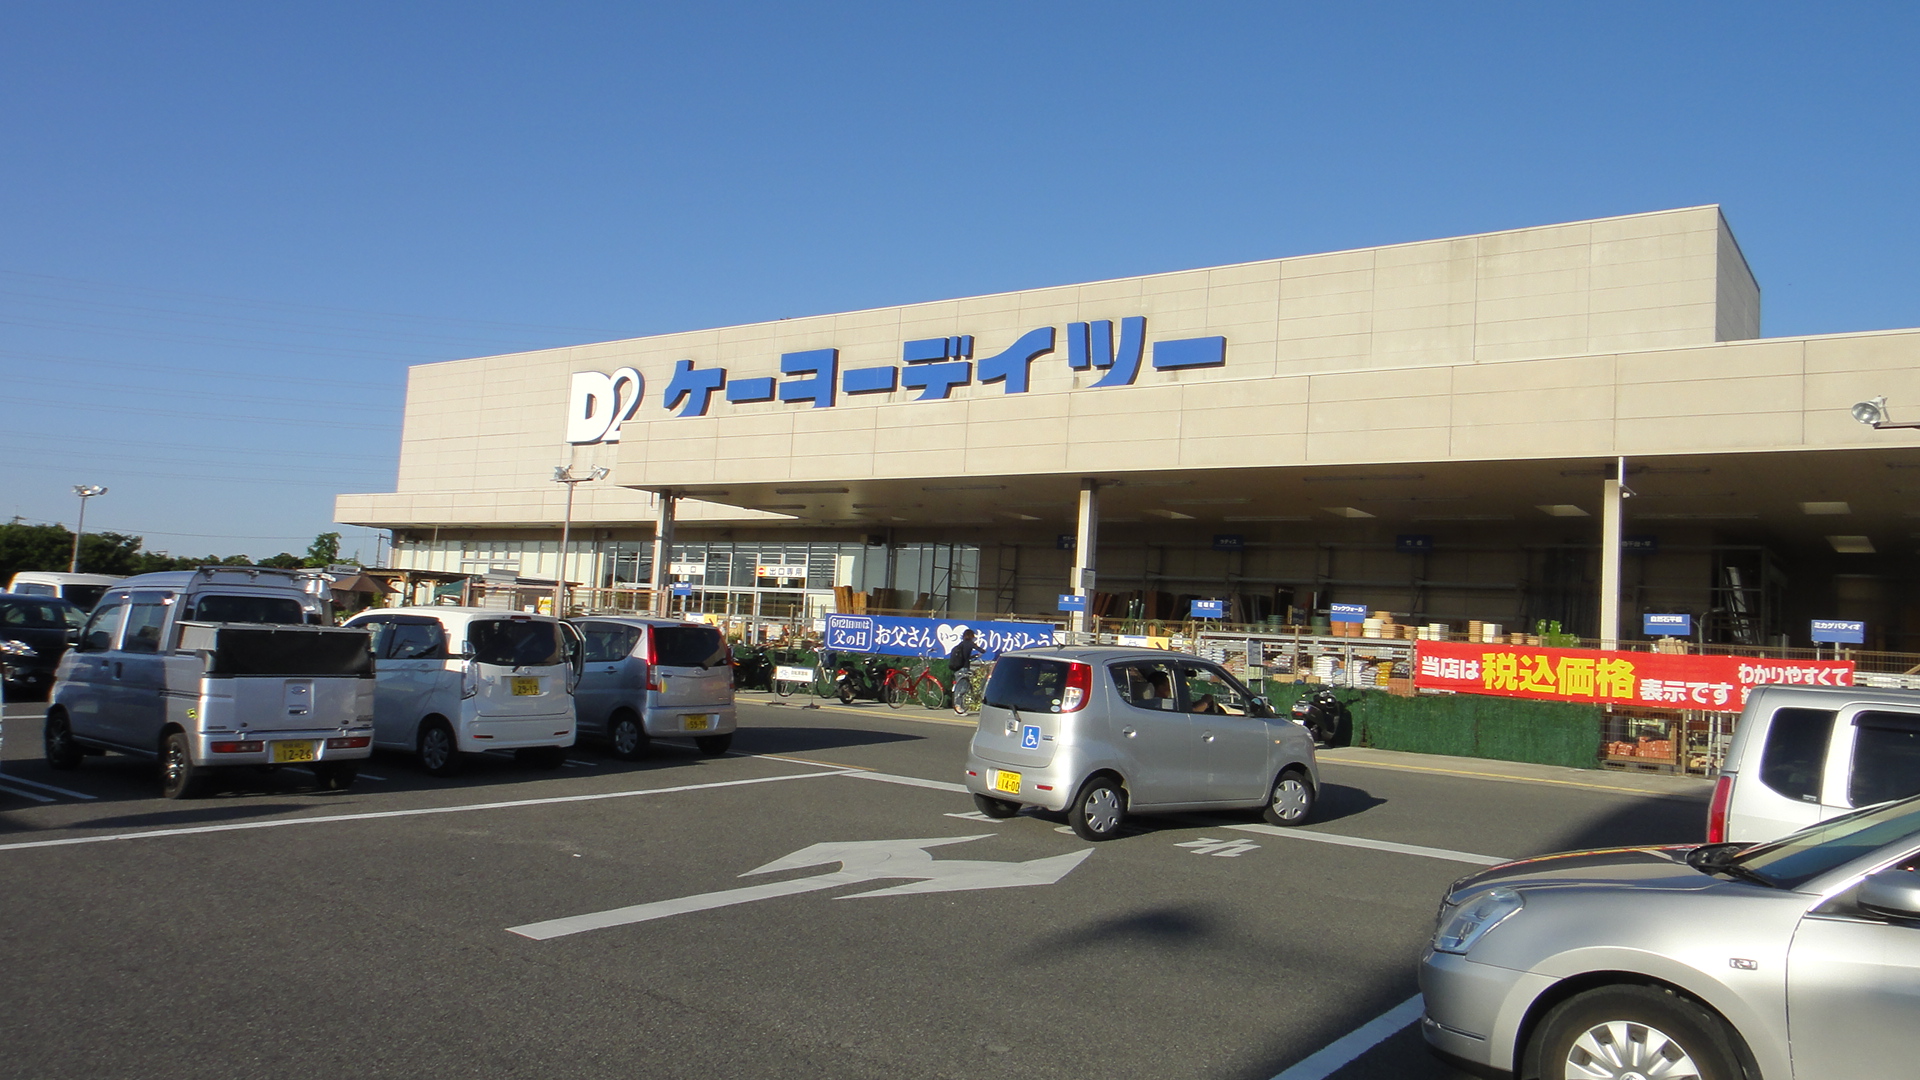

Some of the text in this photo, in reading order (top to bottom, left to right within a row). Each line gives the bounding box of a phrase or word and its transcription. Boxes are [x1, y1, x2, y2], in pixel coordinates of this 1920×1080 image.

[663, 316, 1226, 418] ケーヨーデイツー
[676, 565, 697, 573] 入口
[769, 567, 803, 577] 出口専用
[1331, 604, 1364, 613] ロックウォール
[832, 629, 867, 646] 父の日
[874, 624, 1051, 653] お父さん いつ ありがとう
[1421, 655, 1480, 680] 当店は
[1481, 652, 1636, 699] 税込価格
[1639, 678, 1734, 706] 表示です
[1738, 663, 1849, 687] わかりやすくて
[282, 749, 313, 760] 12-26
[1001, 779, 1020, 792] 14-00
